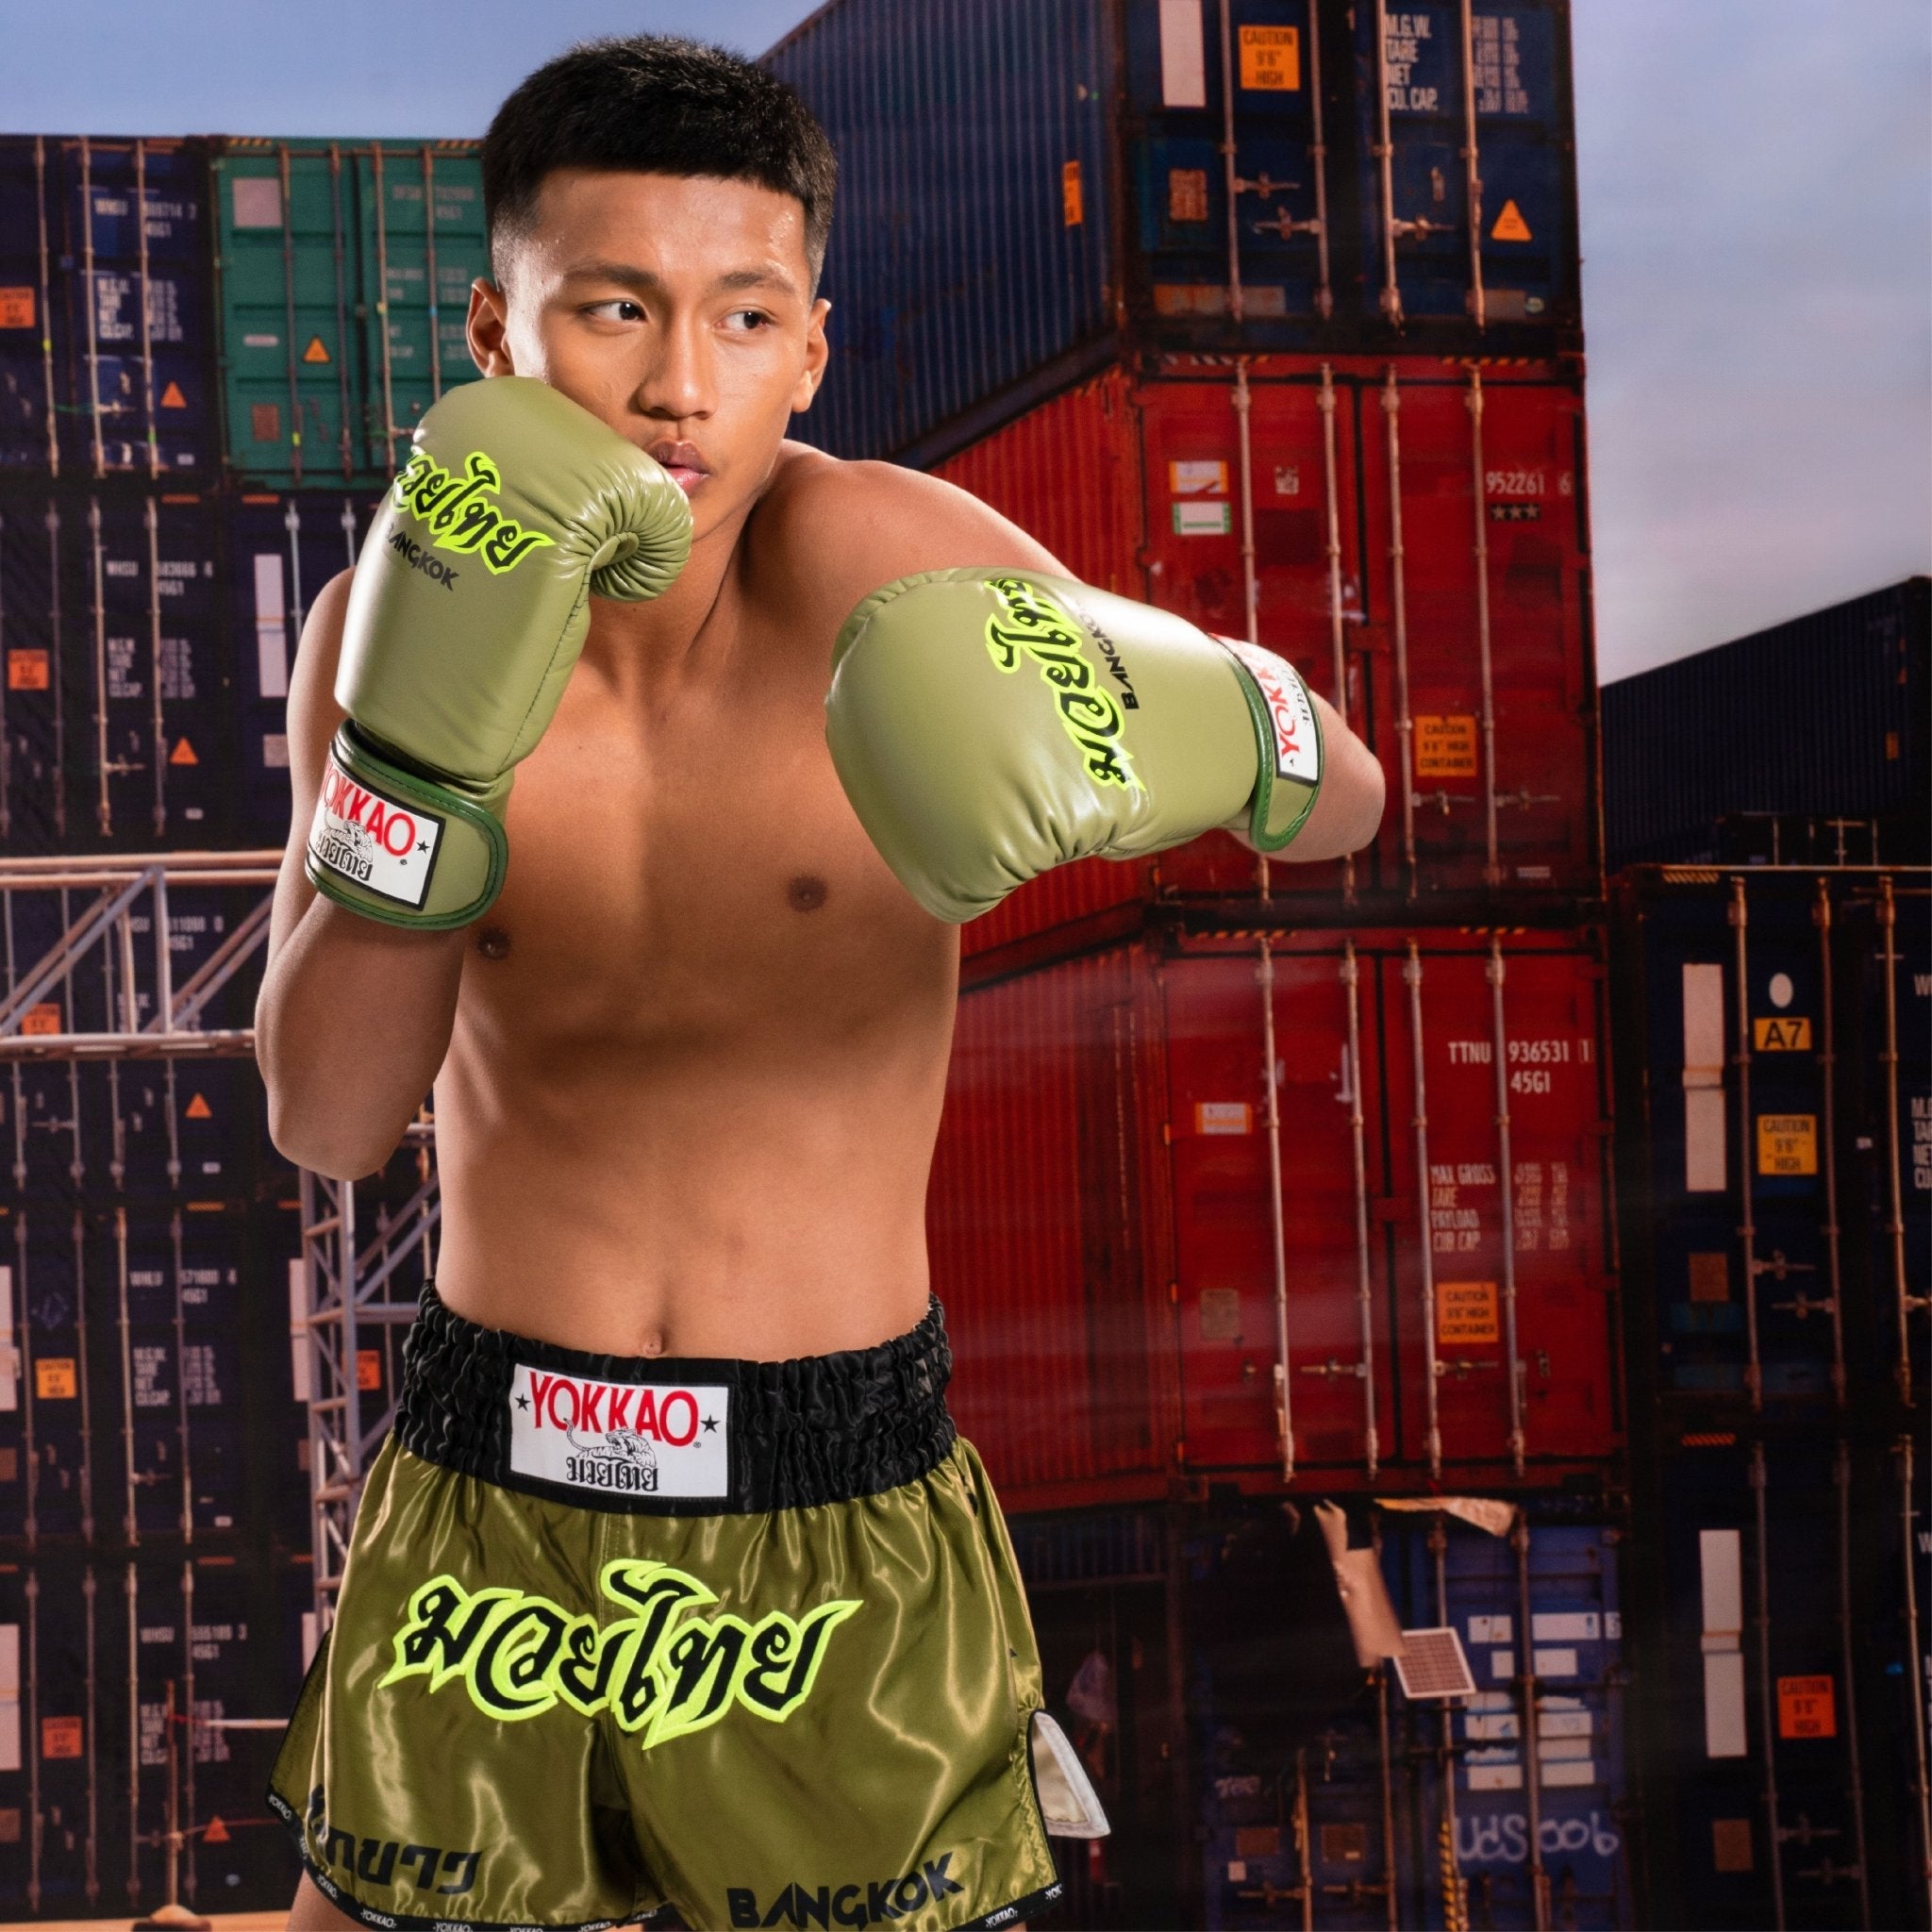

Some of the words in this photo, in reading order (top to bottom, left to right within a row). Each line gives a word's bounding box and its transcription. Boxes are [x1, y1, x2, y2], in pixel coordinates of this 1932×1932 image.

[1242, 29, 1293, 46] CAUTION
[1486, 471, 1545, 495] 952261
[1558, 472, 1572, 496] 6
[387, 524, 459, 592] ANGKOK
[1764, 1021, 1803, 1048] A7
[1448, 1041, 1491, 1064] TTNU
[1508, 1040, 1569, 1063] 936531
[1510, 1070, 1551, 1094] 45G1
[1763, 1119, 1810, 1134] CAUTION
[1445, 1290, 1489, 1302] CAUTION
[1441, 1323, 1494, 1336] CONTAINER
[529, 1371, 699, 1448] YOKKAO
[566, 1456, 659, 1492] มวยไทย
[377, 1558, 863, 1750] มวยไทย
[726, 1851, 966, 1932] BANGKOK
[362, 1908, 395, 1929] YOKKAO
[985, 1907, 1017, 1929] YOKKAO
